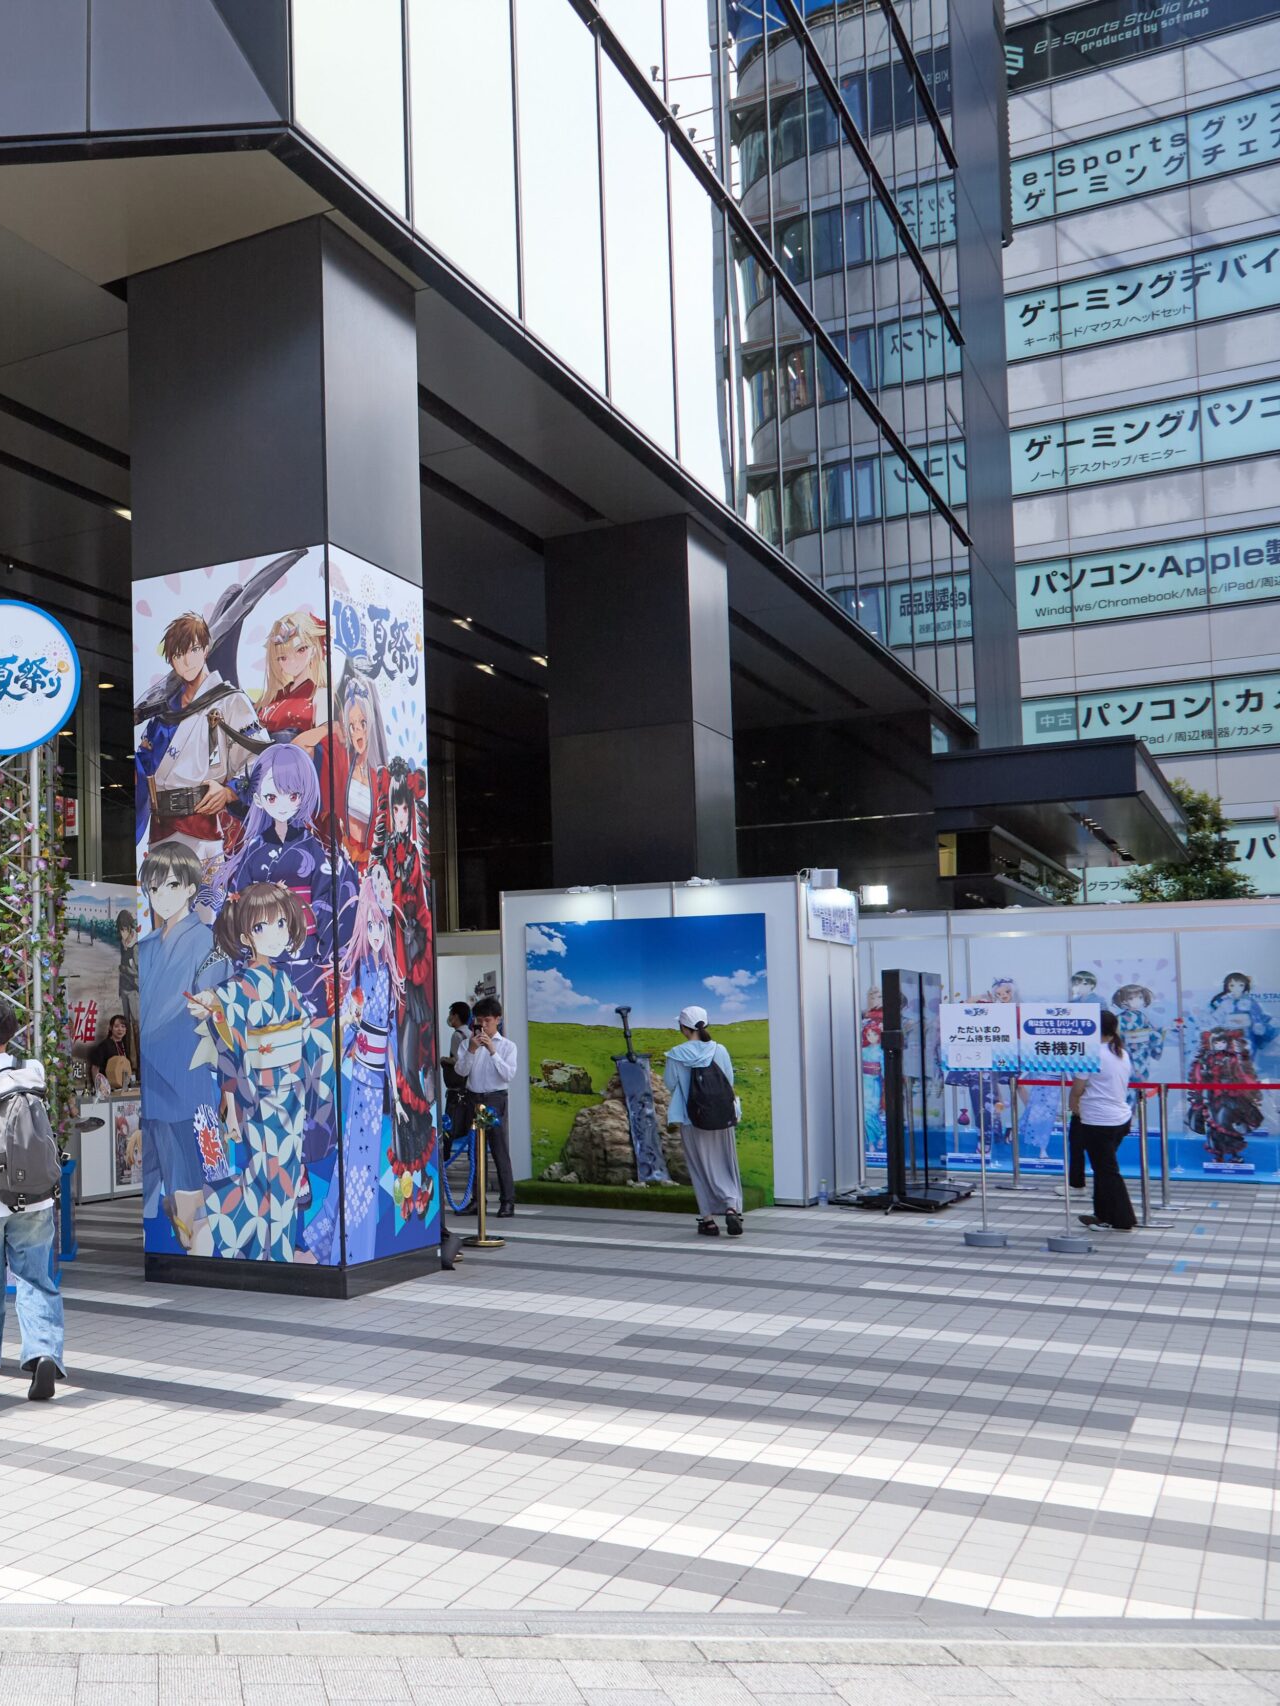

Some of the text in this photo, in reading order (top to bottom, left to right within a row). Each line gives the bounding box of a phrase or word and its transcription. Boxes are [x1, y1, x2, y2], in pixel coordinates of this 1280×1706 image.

[1123, 2, 1181, 27] Studio
[1080, 7, 1209, 54] produced by sofmap
[366, 604, 419, 686] 夏祭り
[1040, 688, 1280, 729] 中古 パソコン・カ
[949, 1034, 1010, 1043] ゲーム待ち時間
[957, 1026, 1001, 1034] ただいまの
[1034, 1041, 1086, 1056] 待機列
